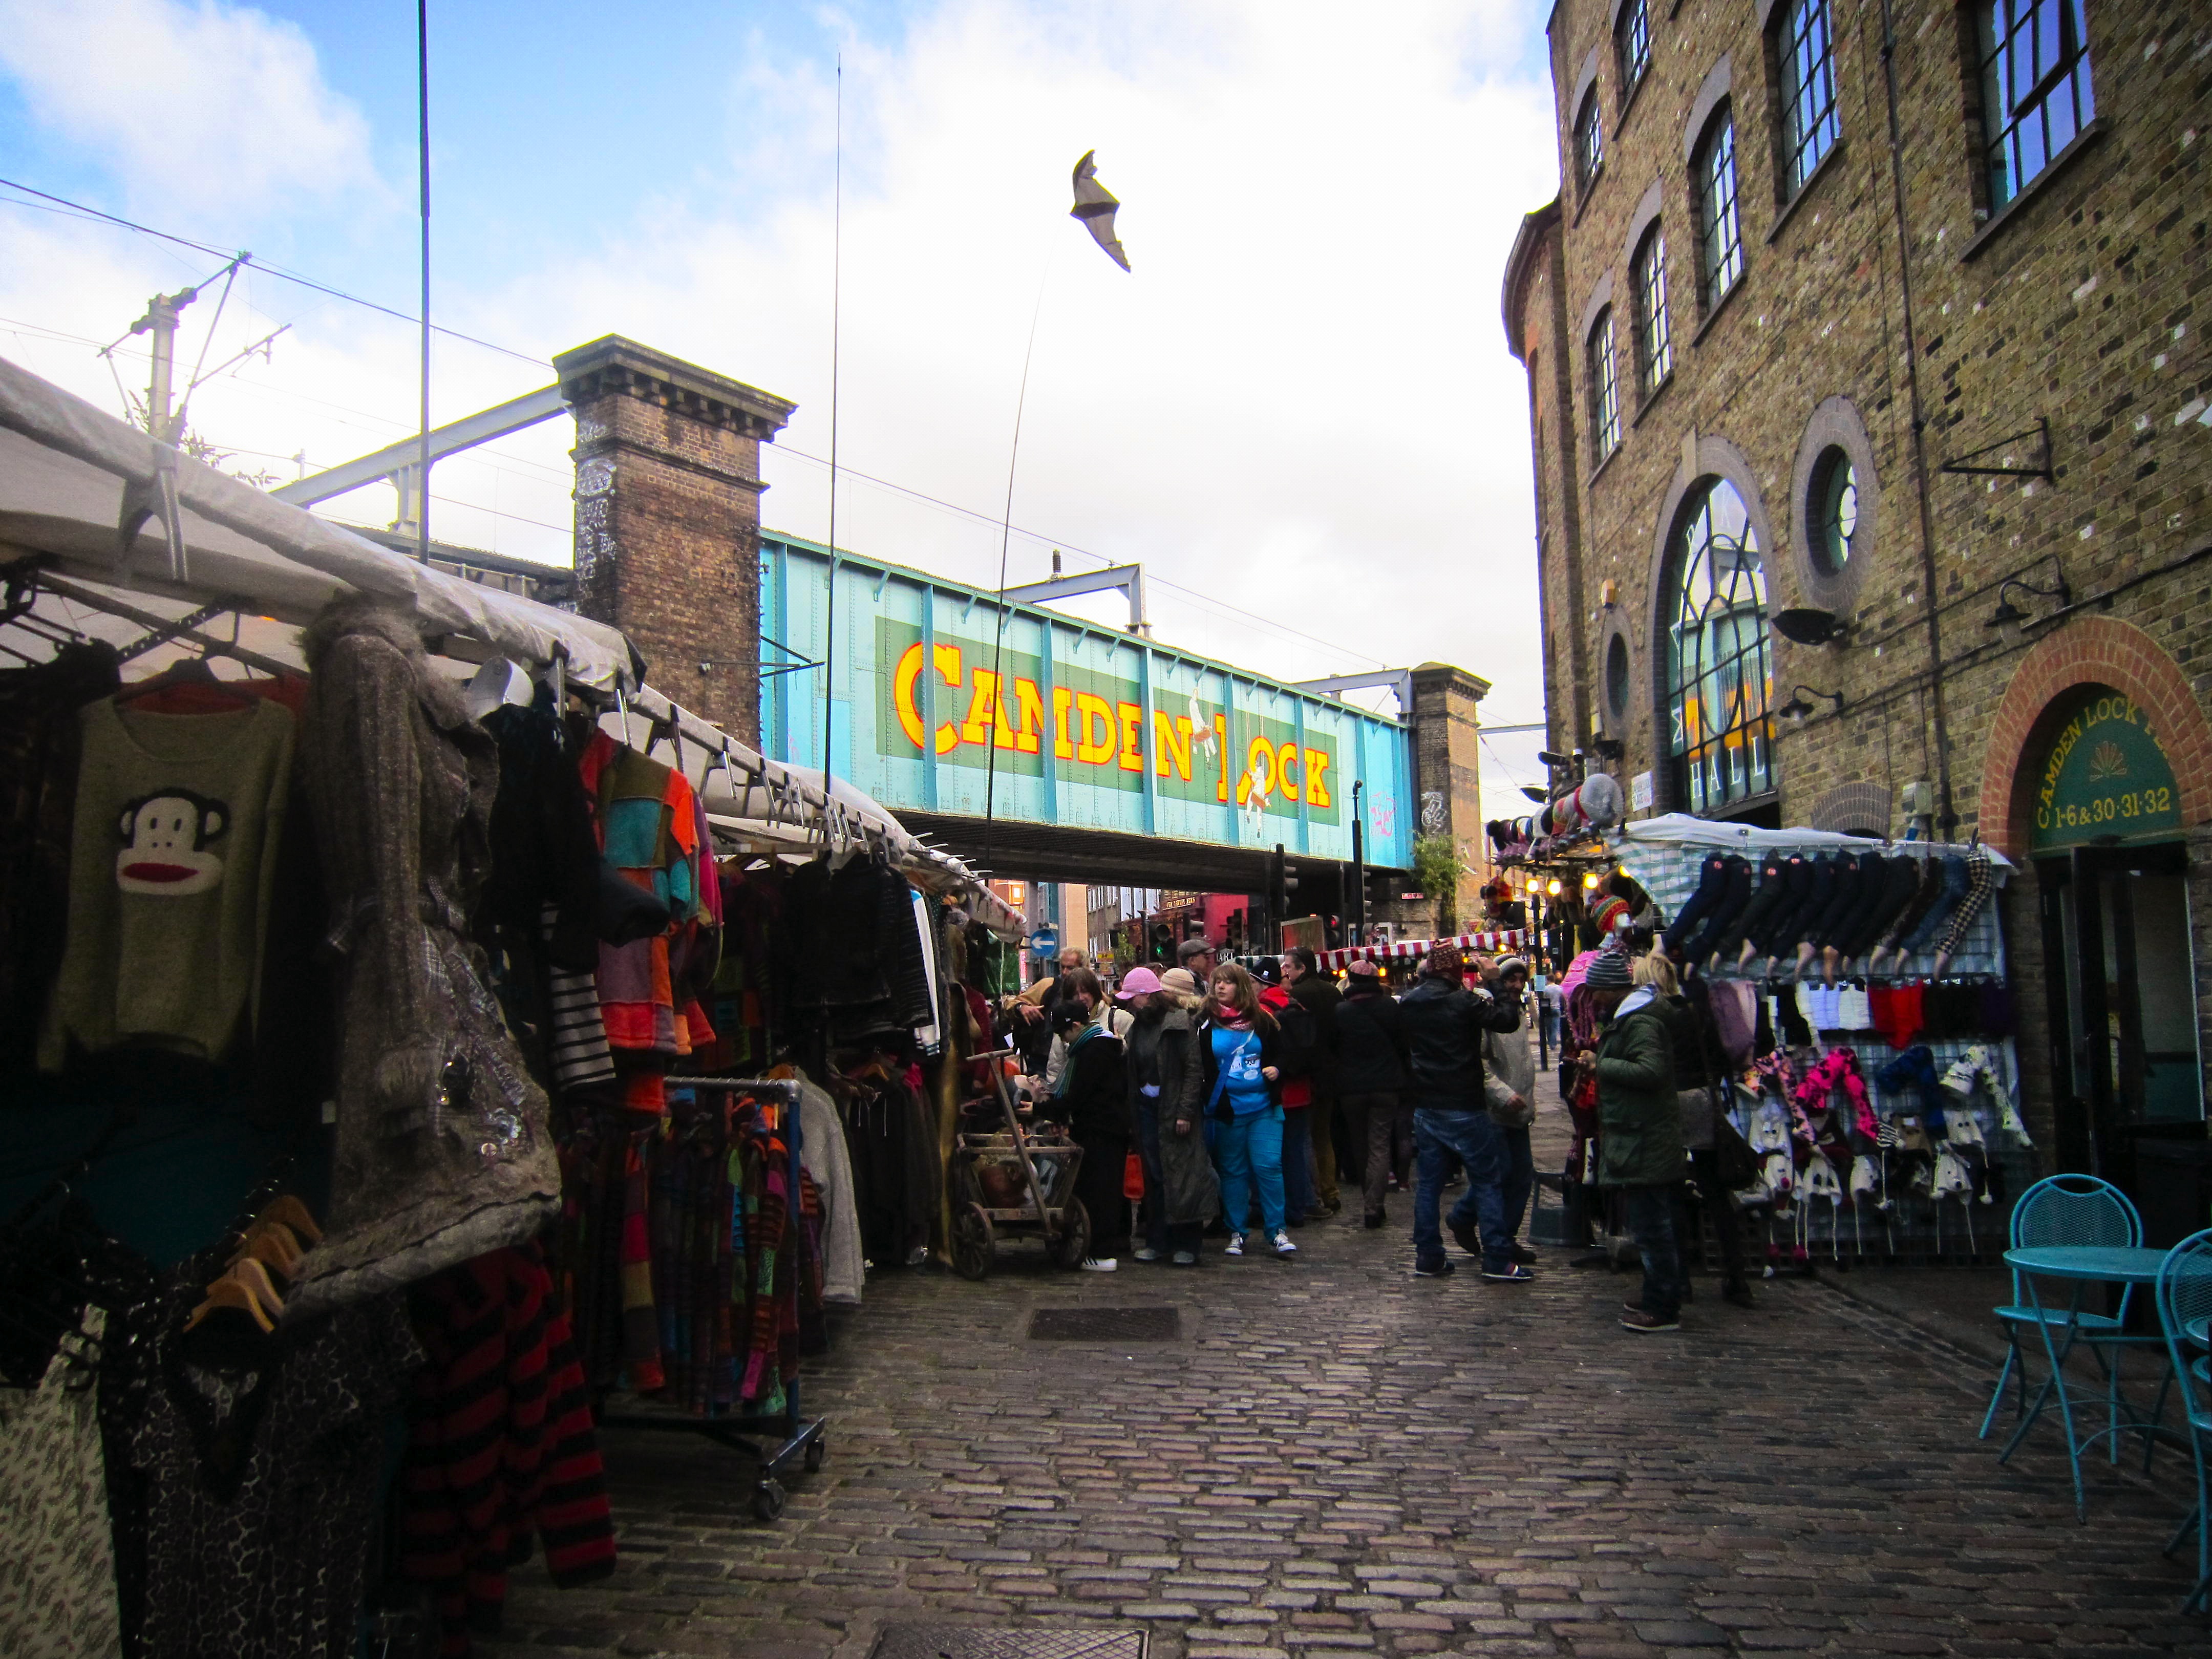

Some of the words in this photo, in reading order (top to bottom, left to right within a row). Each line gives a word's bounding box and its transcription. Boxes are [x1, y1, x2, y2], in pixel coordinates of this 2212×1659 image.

[894, 641, 1194, 782] CAMDEN
[1215, 711, 1331, 809] LOCK
[1690, 736, 1765, 799] HALL
[2037, 717, 2082, 829] CAMDEN
[2083, 696, 2138, 728] LOCK
